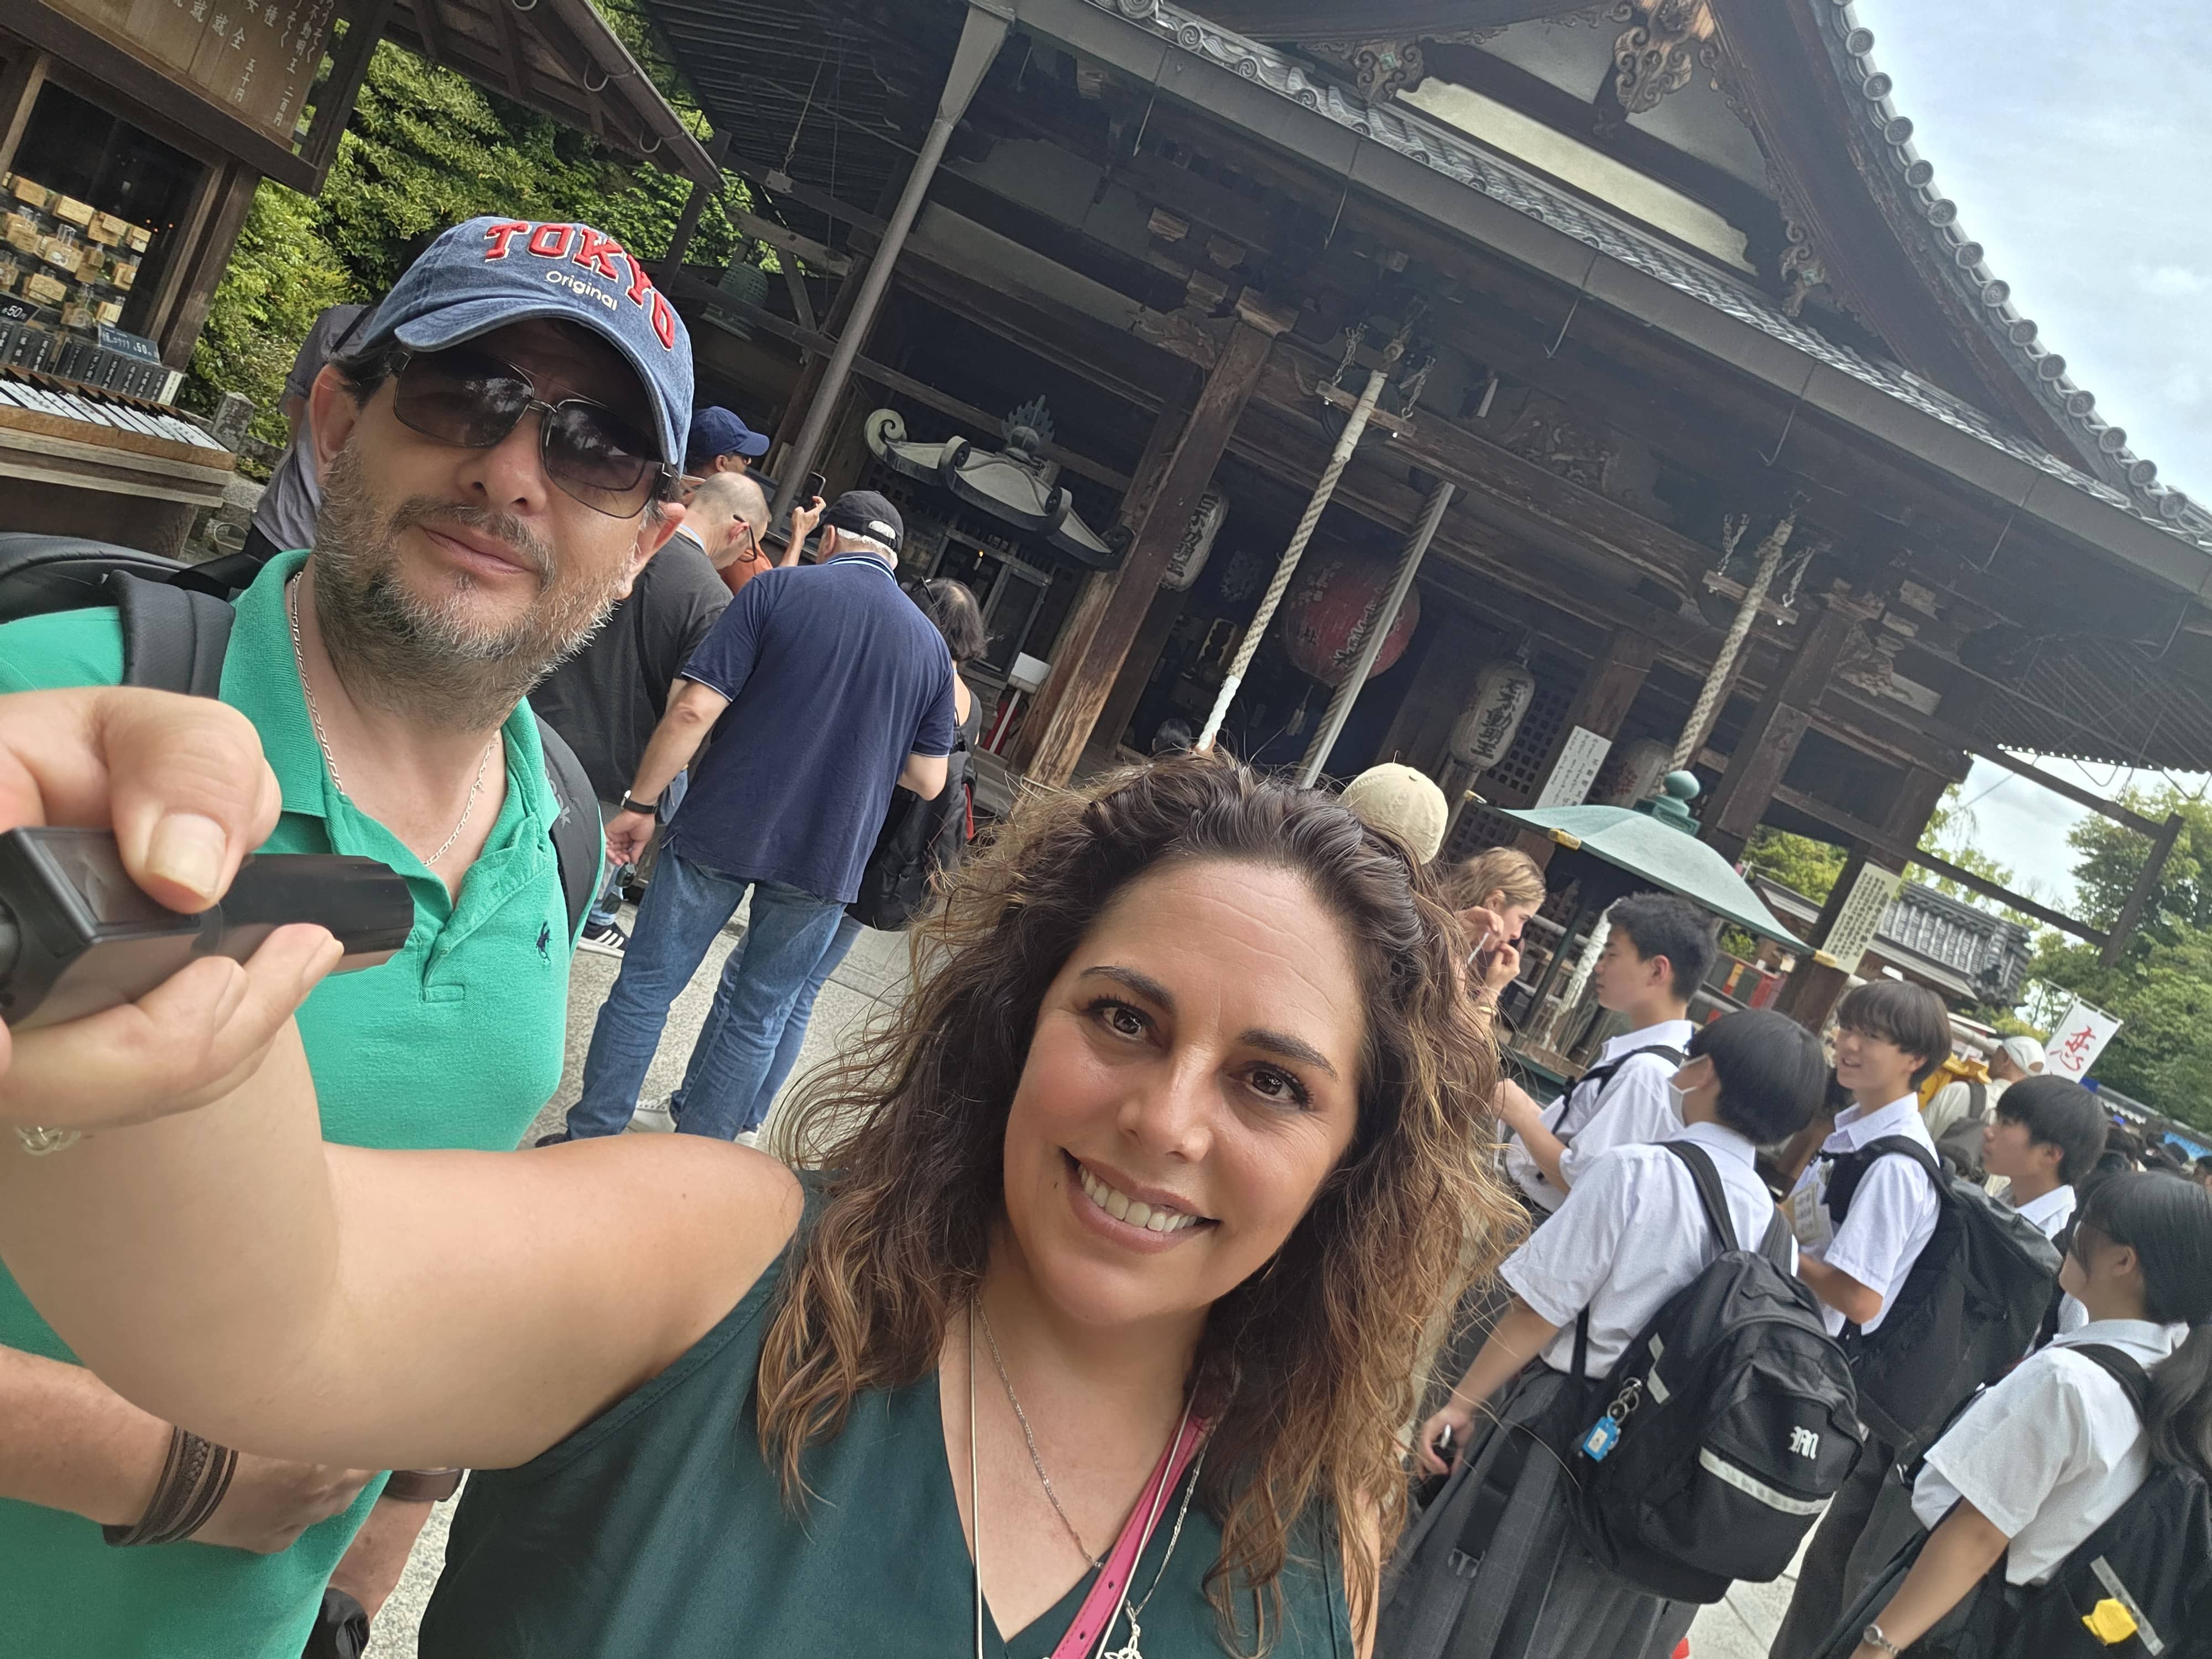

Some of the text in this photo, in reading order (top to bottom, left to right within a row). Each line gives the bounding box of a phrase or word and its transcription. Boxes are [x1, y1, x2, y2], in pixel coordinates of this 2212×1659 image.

[274, 86, 294, 127] 二百円
[483, 221, 676, 352] TOKYO
[545, 270, 618, 311] Original
[2049, 1025, 2096, 1072] 恋
